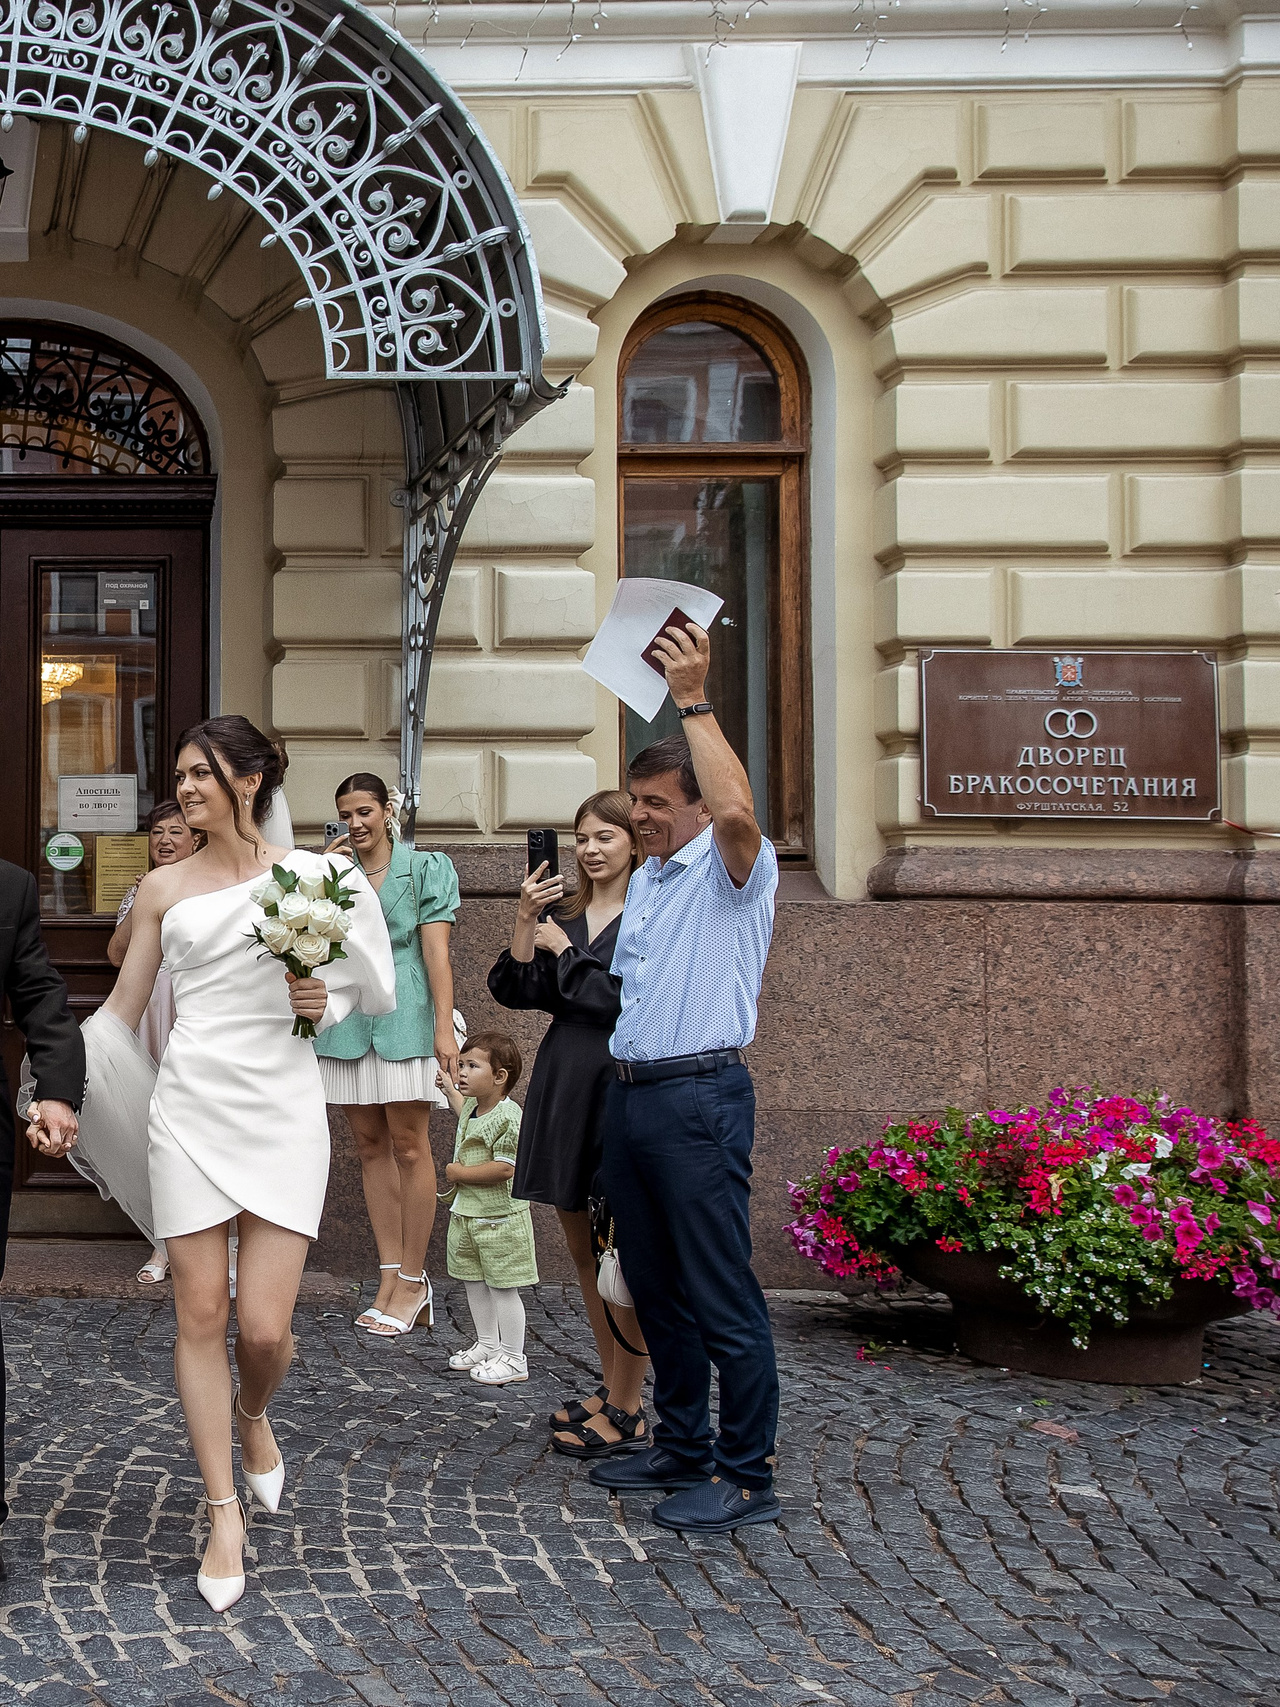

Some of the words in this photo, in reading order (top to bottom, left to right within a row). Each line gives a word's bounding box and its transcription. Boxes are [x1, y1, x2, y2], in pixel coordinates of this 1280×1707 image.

[1016, 746, 1128, 769] ДВОРЕЦ
[75, 787, 121, 797] Апостиль
[948, 775, 1197, 797] БРАКОСОЧЕТАНИЯ
[1112, 801, 1129, 812] 52
